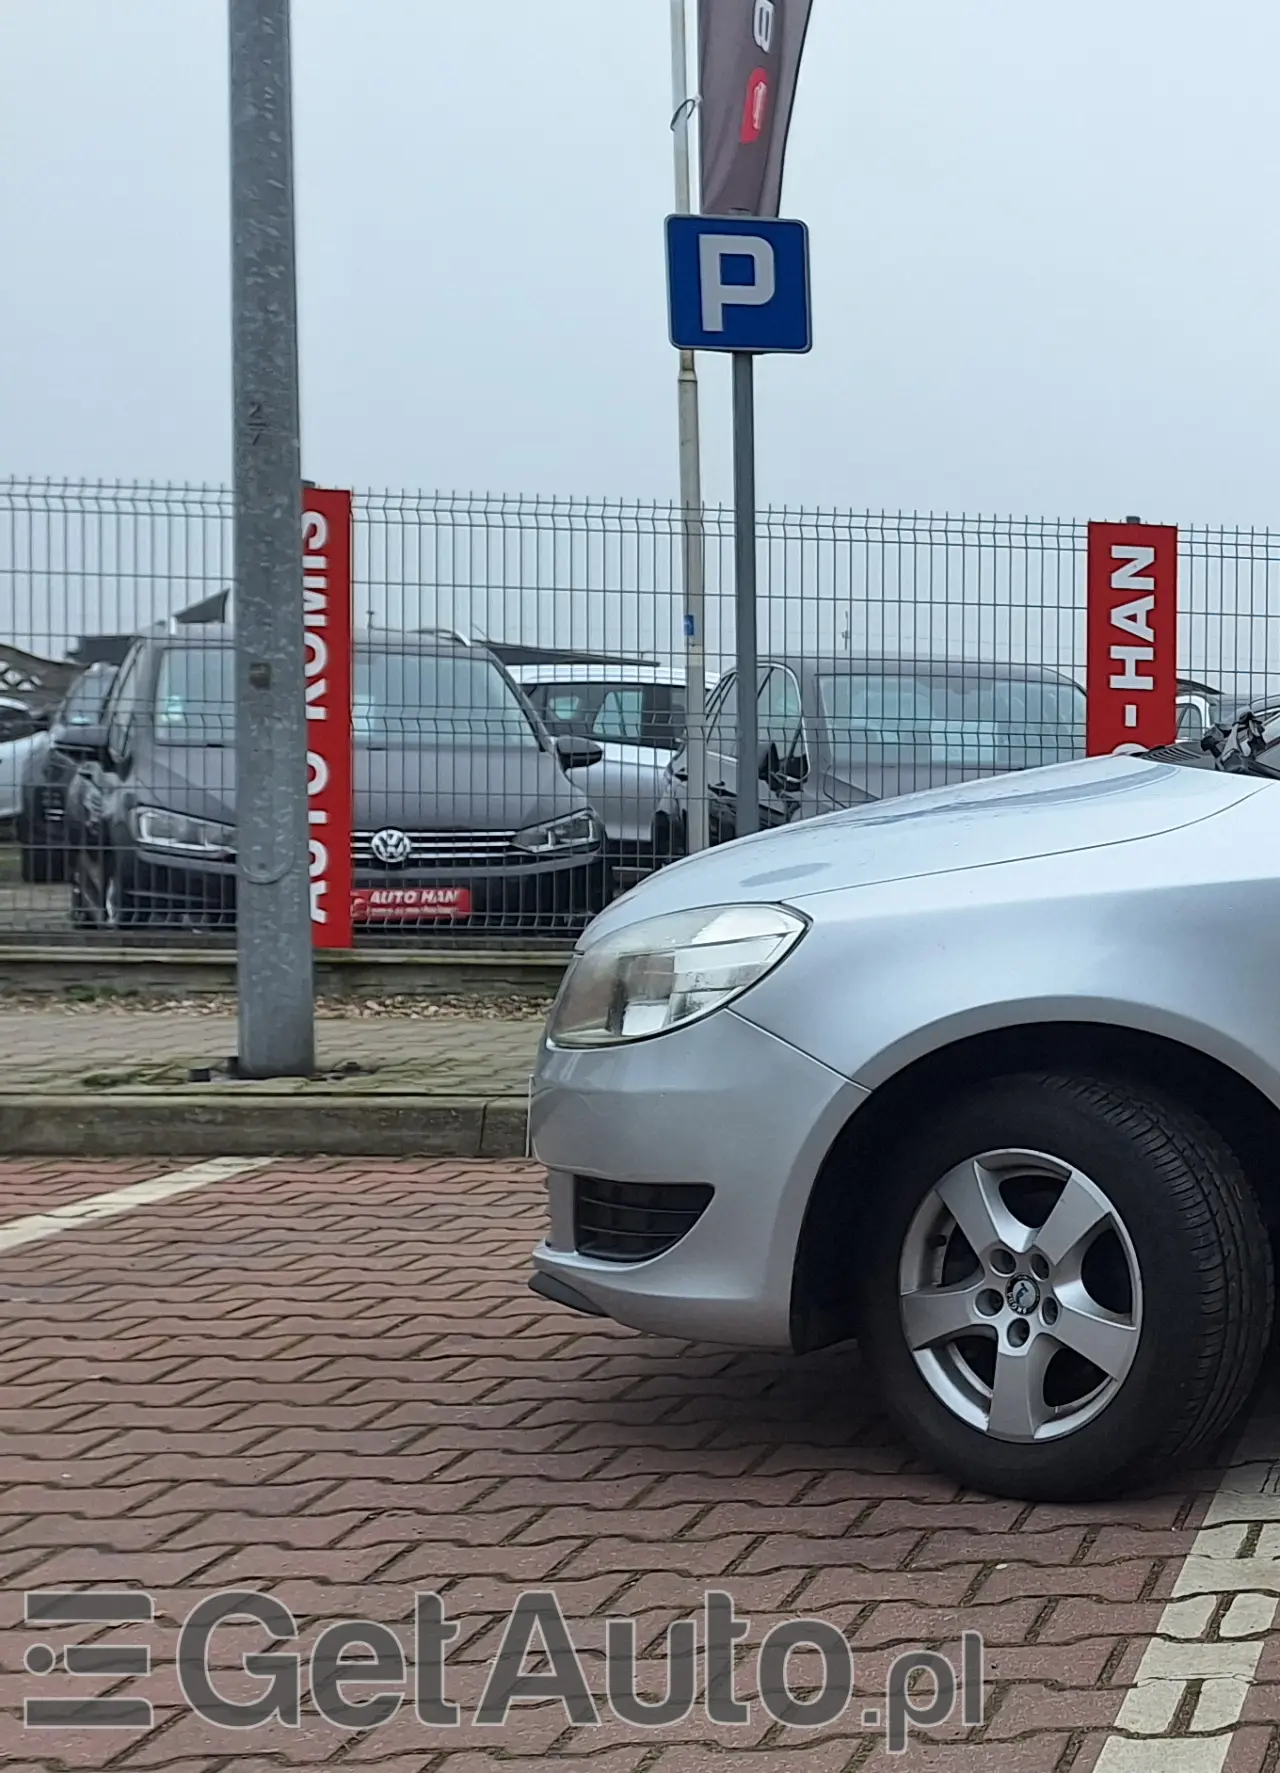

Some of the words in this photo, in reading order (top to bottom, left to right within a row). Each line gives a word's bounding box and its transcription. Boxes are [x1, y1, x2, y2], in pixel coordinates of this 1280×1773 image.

[699, 234, 775, 332] P
[370, 890, 418, 904] AUTO
[420, 889, 458, 904] HAN
